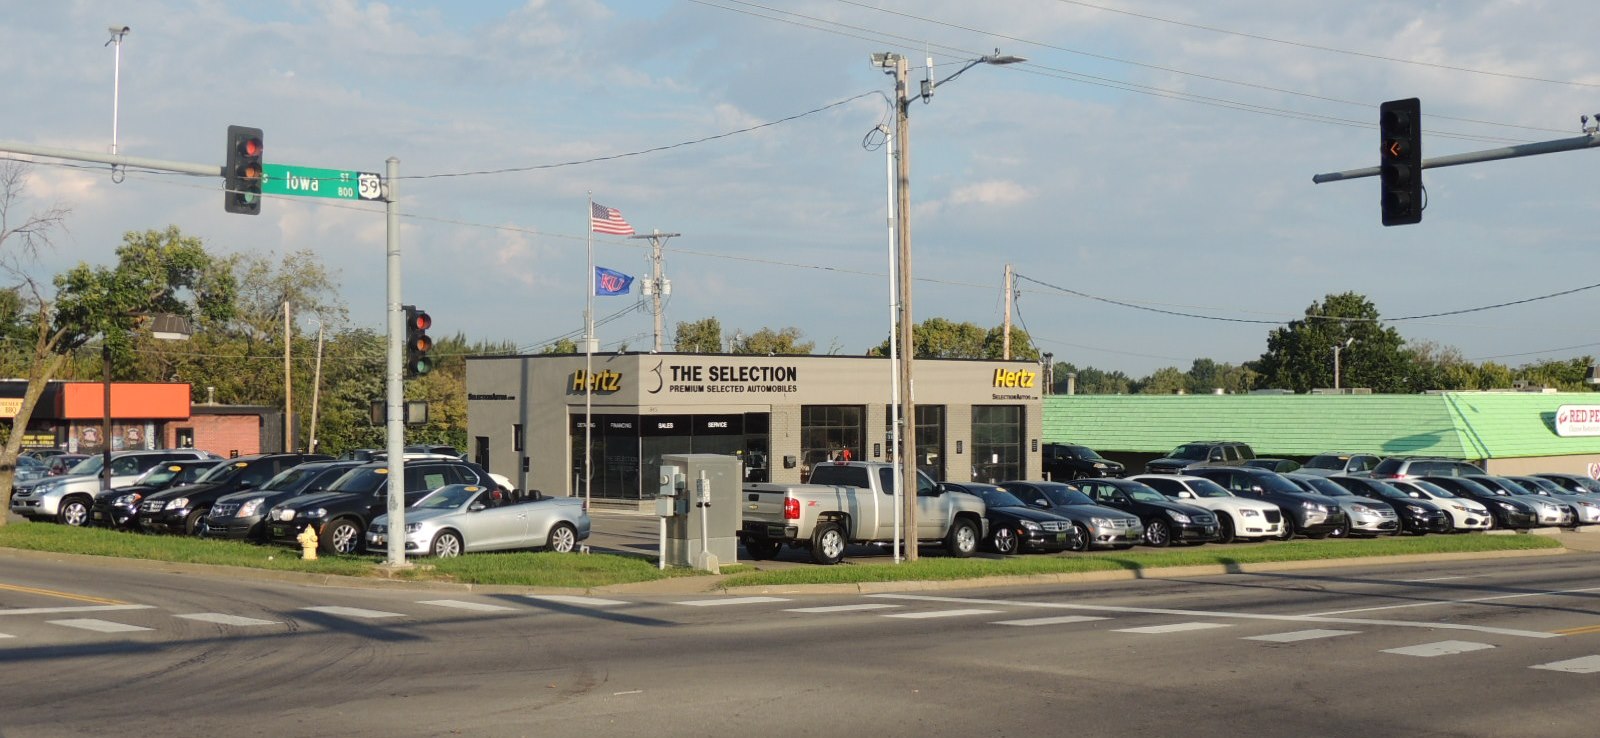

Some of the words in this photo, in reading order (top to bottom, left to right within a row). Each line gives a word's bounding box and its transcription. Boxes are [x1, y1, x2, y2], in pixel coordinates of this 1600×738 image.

[286, 170, 319, 191] Iowa
[340, 172, 350, 182] ST
[360, 178, 378, 193] 59
[338, 187, 354, 197] 800
[601, 271, 625, 292] KU
[573, 368, 622, 391] Hertz
[670, 366, 702, 382] THE
[709, 366, 797, 382] SELECTION
[993, 368, 1036, 388] Hertz
[669, 385, 704, 393] PREMIUM
[706, 385, 744, 393] SELECTED
[747, 385, 798, 393] AUTOMOBILES
[1569, 409, 1587, 423] RED
